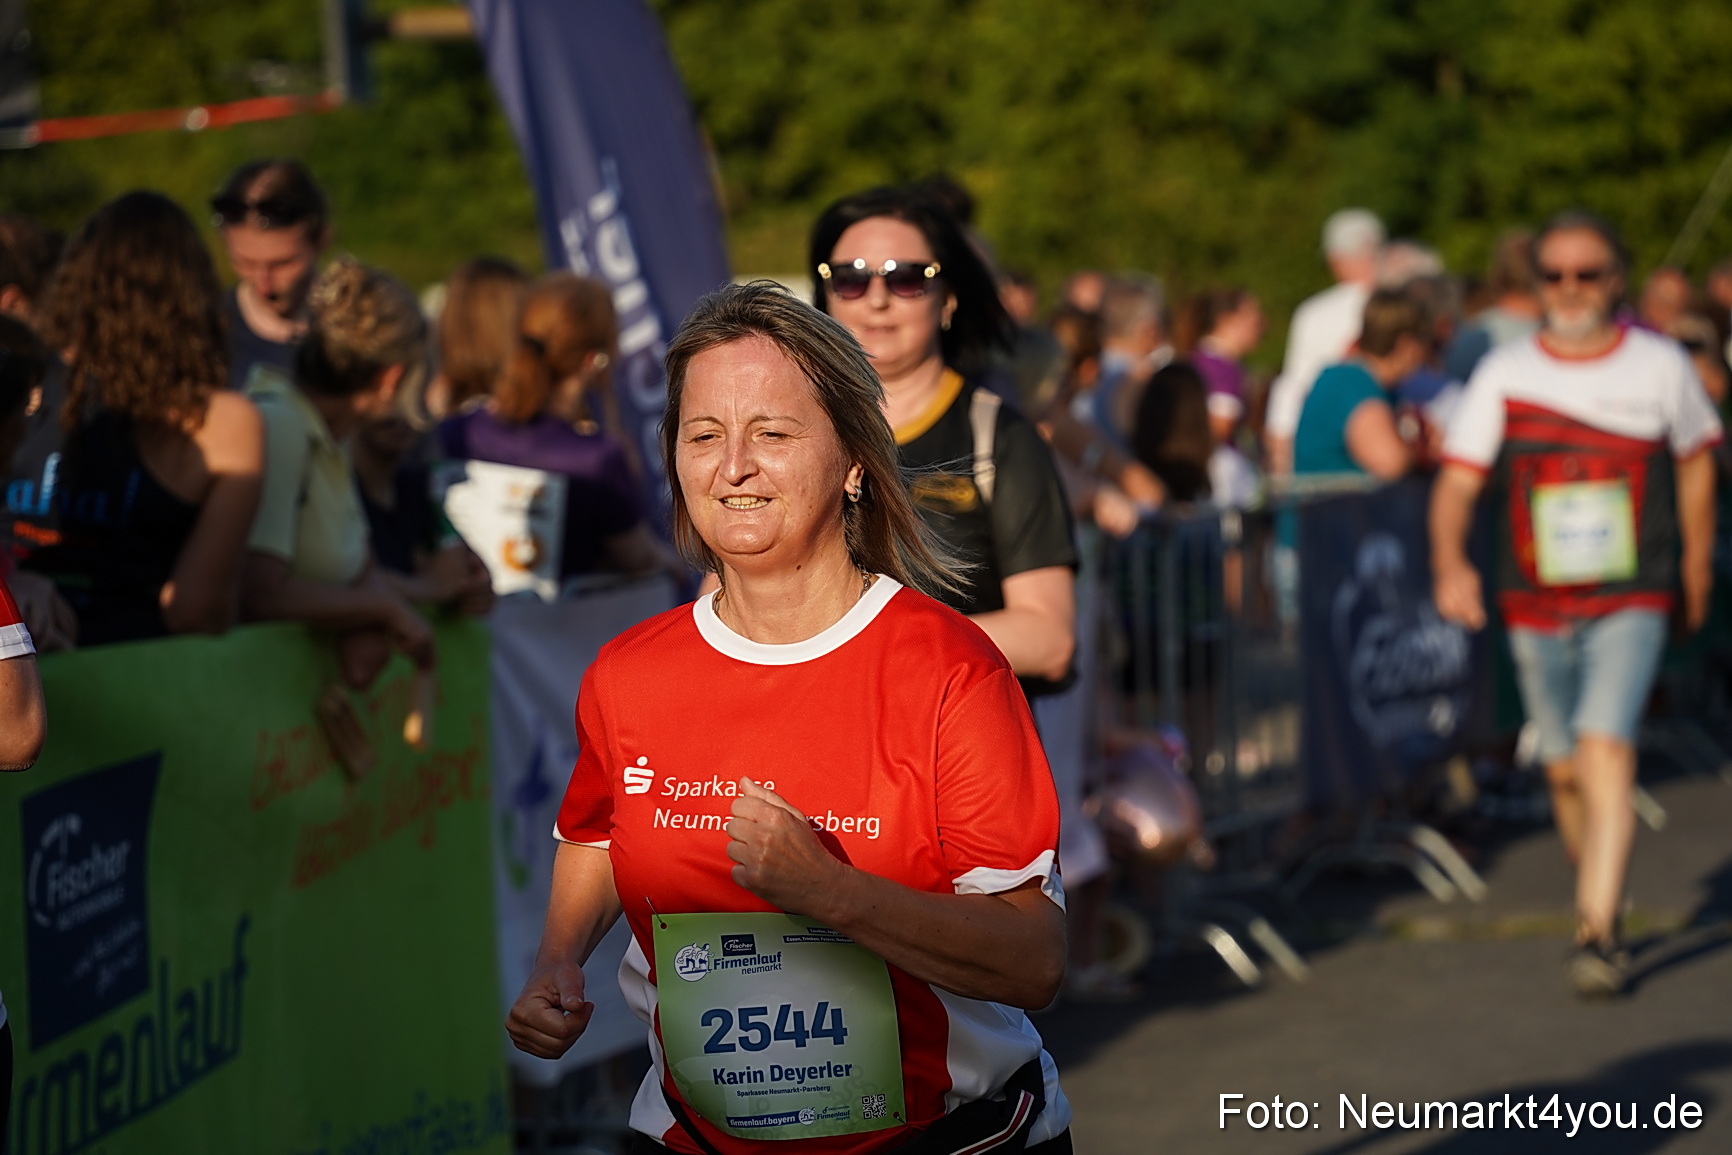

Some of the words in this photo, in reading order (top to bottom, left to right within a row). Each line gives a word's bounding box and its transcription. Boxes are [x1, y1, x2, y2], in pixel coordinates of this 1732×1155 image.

[660, 775, 775, 801] Sparkae
[729, 942, 754, 950] Fischer
[713, 951, 782, 970] Firmenlauf
[741, 963, 782, 975] neumarkt
[701, 1001, 848, 1054] 2544
[712, 1066, 765, 1086] Karin
[770, 1061, 853, 1084] Deyerler
[736, 1089, 768, 1097] Sparkasse
[769, 1085, 831, 1095] Neumarkt-Parsberg
[817, 1110, 850, 1119] Firmenlauf
[729, 1115, 796, 1127] firmenlauf.bayern
